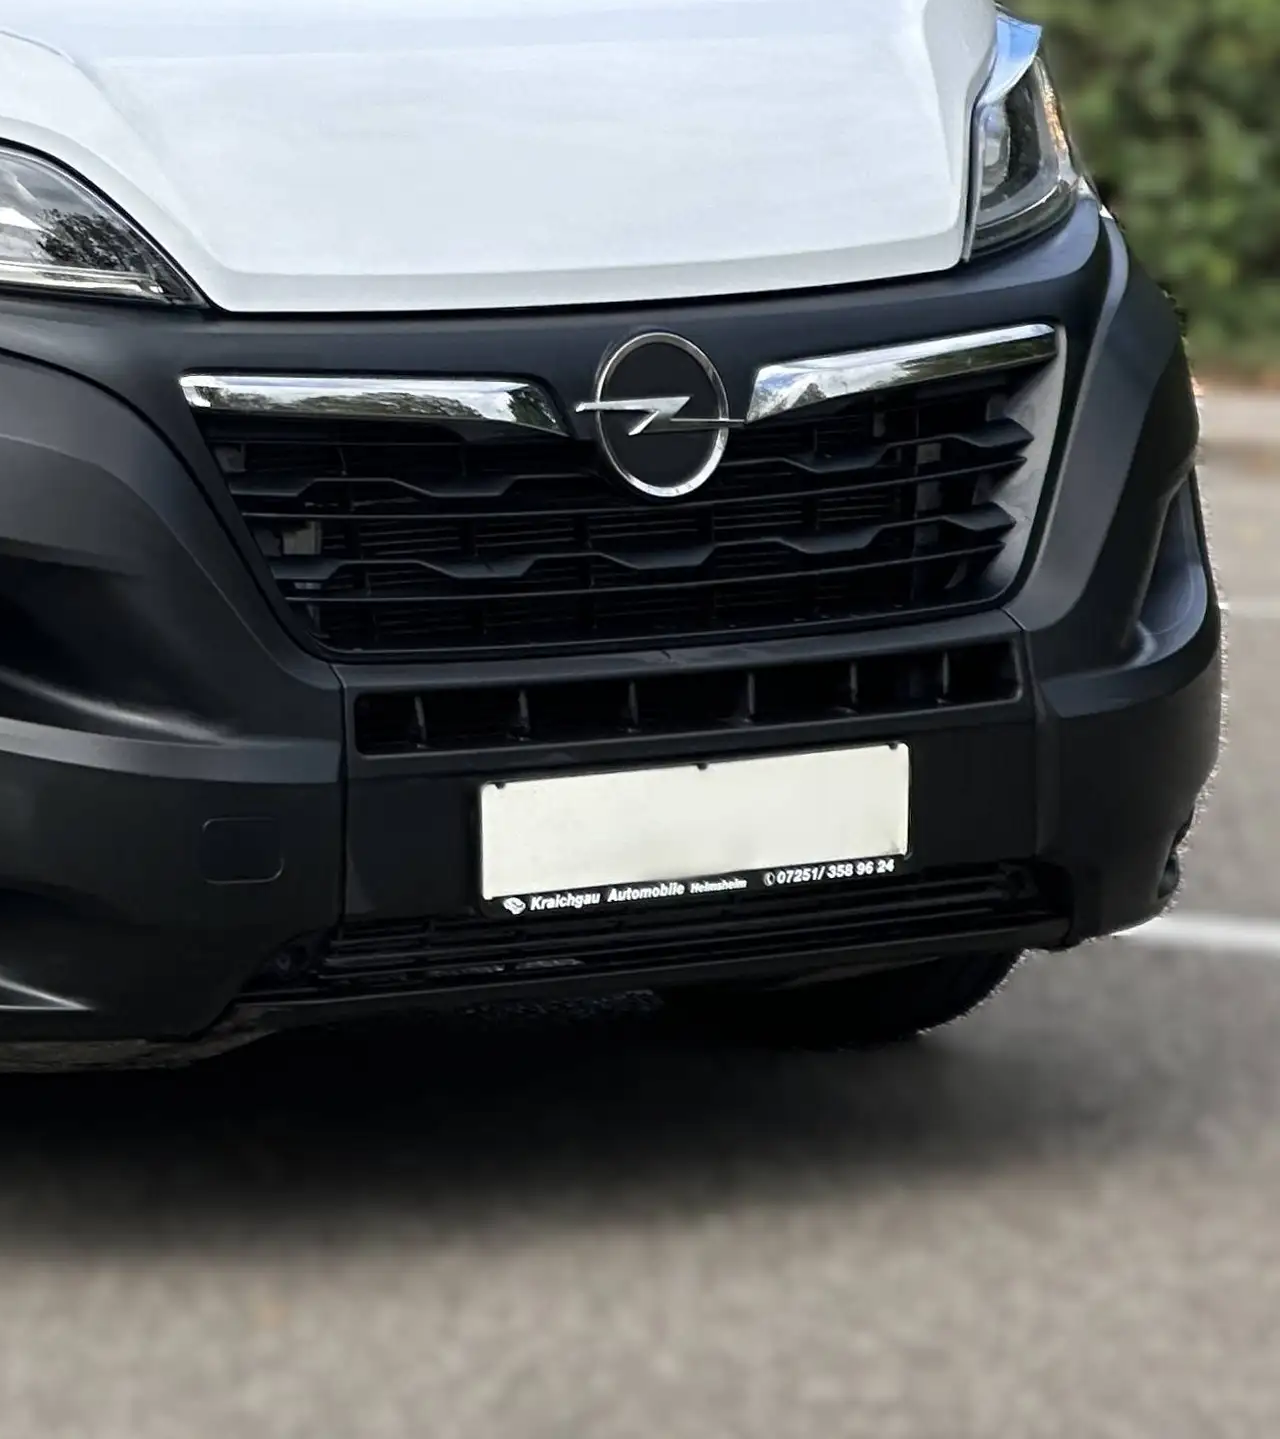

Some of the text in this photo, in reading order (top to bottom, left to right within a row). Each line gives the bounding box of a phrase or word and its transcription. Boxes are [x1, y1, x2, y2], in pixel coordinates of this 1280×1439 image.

[530, 893, 600, 910] Kraichgau
[607, 881, 686, 902] Automobile
[827, 862, 854, 878] 358
[856, 860, 875, 876] 96
[876, 858, 895, 874] 24
